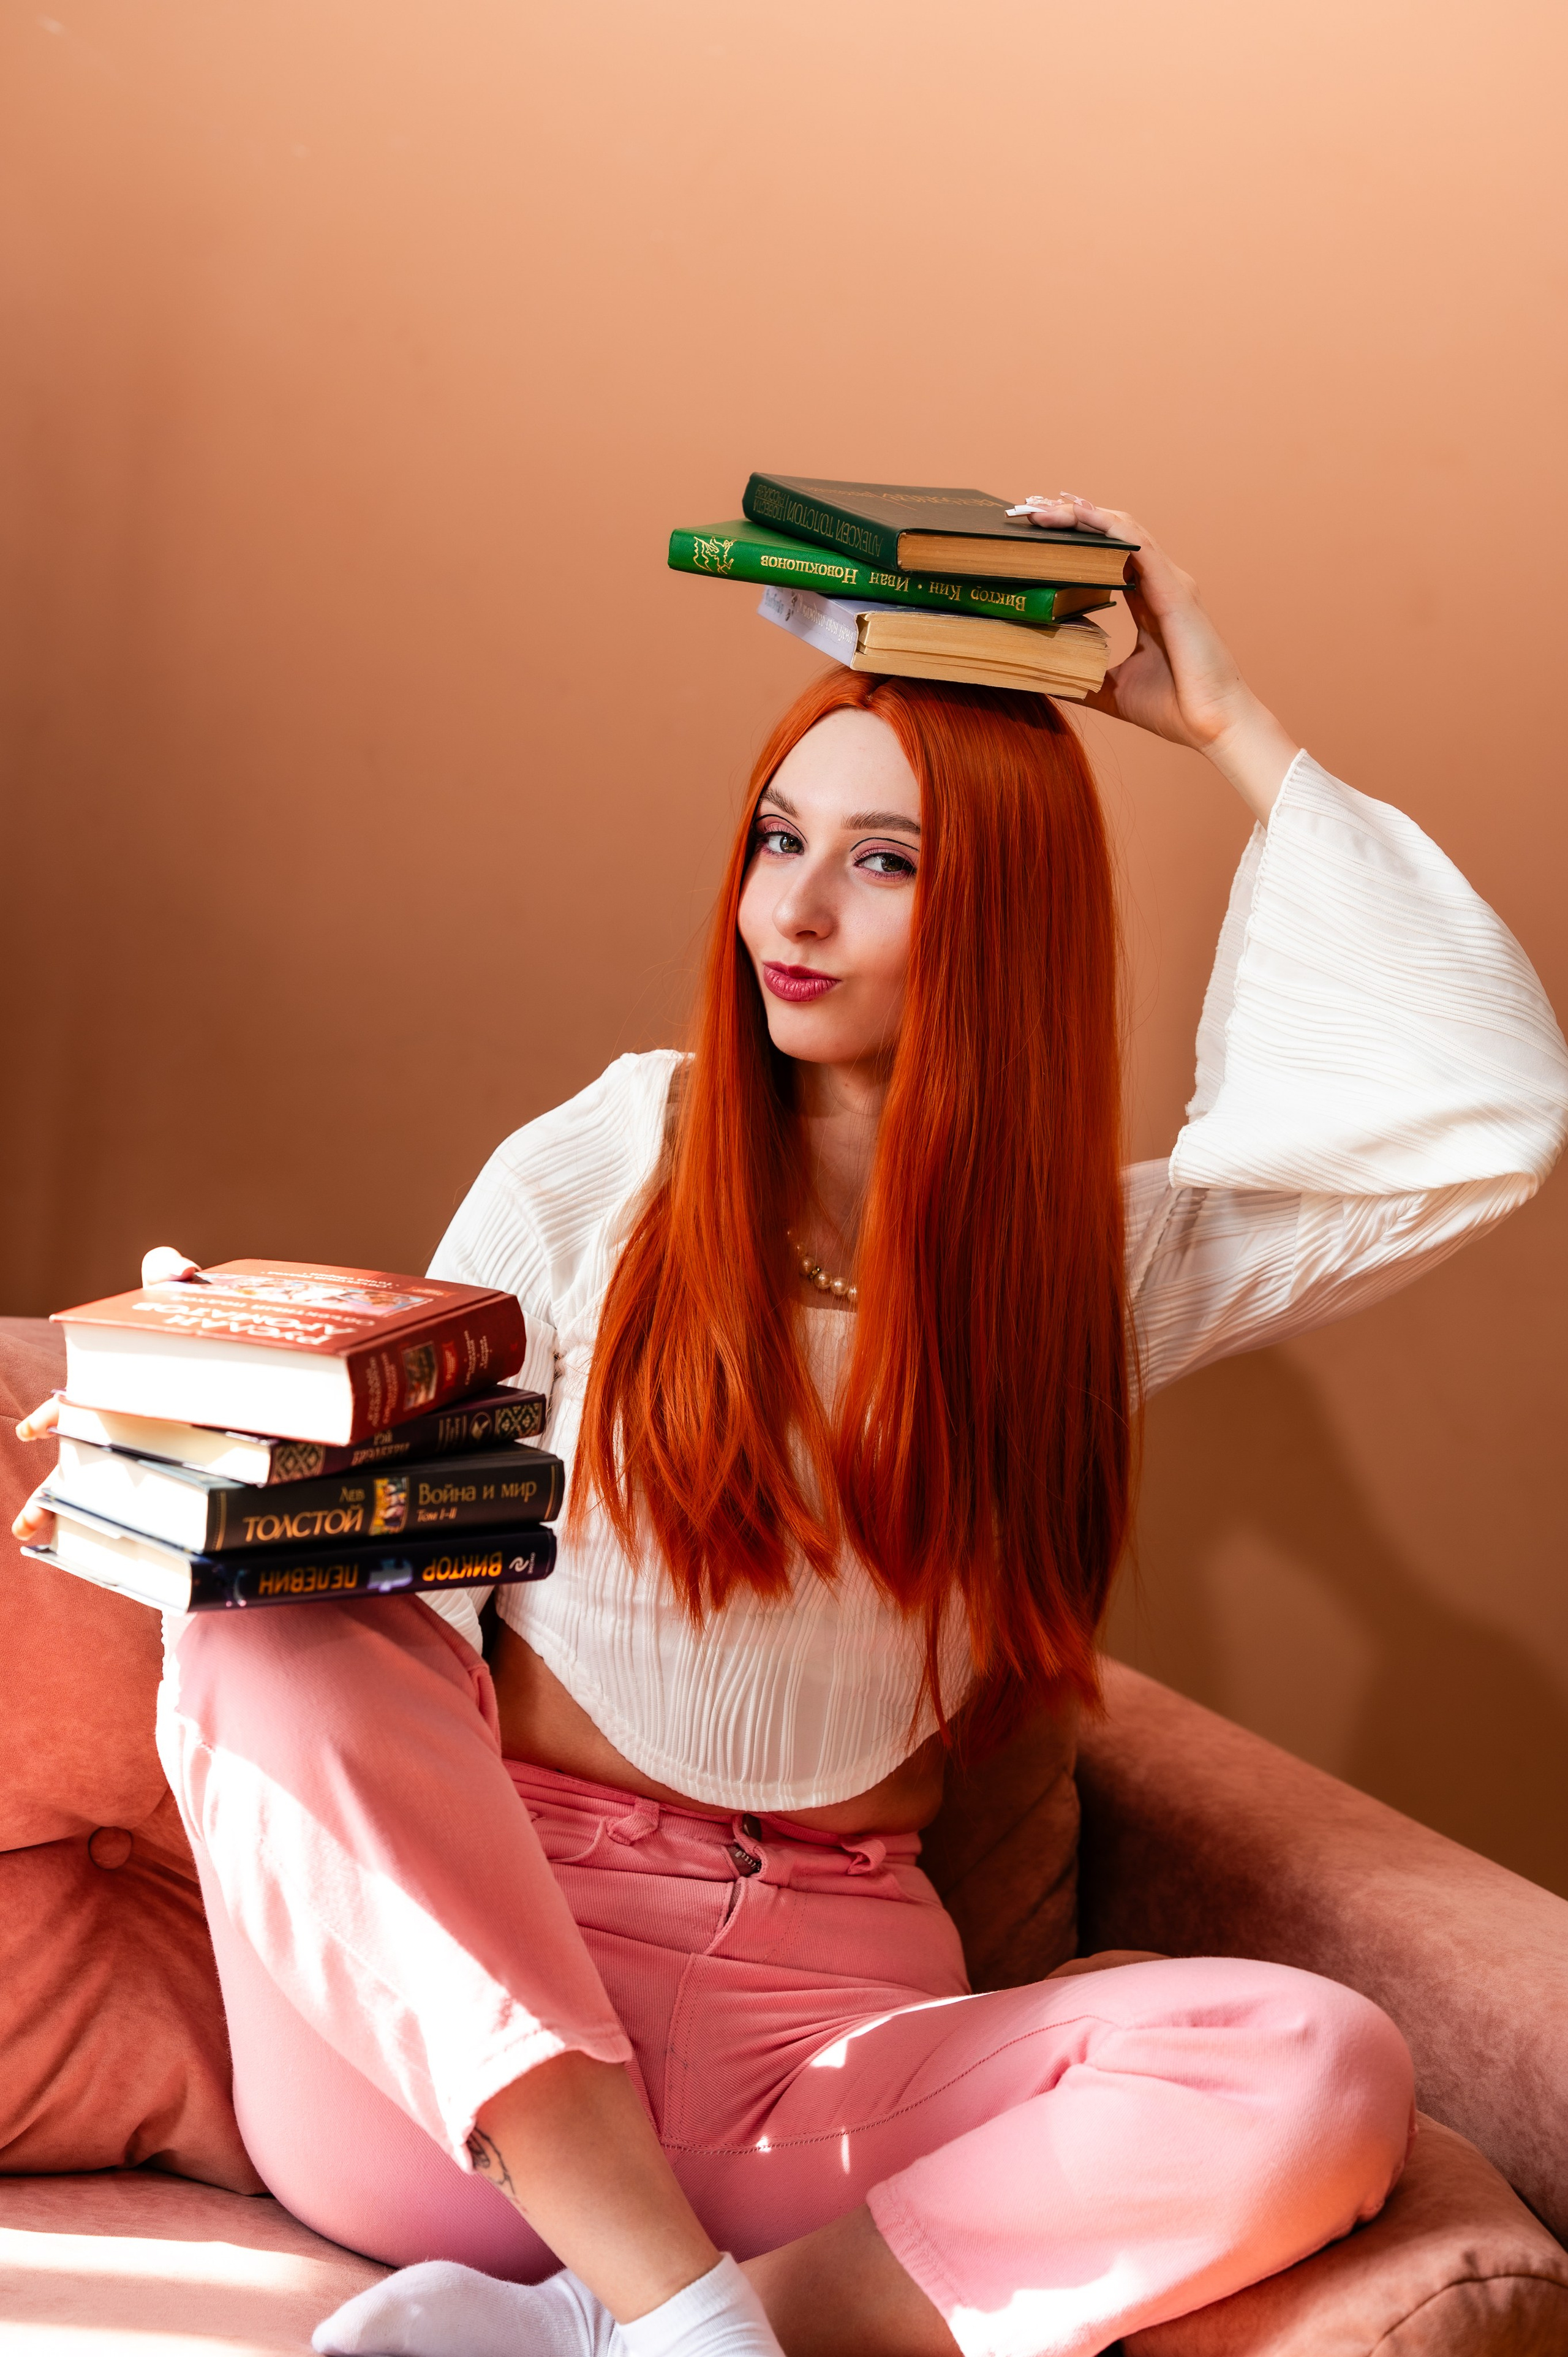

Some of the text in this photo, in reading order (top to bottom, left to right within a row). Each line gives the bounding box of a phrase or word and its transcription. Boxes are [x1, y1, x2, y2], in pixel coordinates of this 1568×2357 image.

[753, 498, 784, 521] ПОВЕСТИ
[755, 484, 786, 506] РАССКАЗЫ
[786, 500, 883, 557] АЛЕКСЕЙ ТОЛСТОЙ
[760, 555, 1027, 611] Виктор Кин Иван Новокшонов
[132, 1302, 357, 1335] АРОМАТОВ
[164, 1314, 334, 1346] РУСЛАН
[418, 1481, 537, 1505] Война и мир
[243, 1504, 364, 1542] ТОЛСТОЙ
[417, 1509, 439, 1523] Том
[258, 1563, 358, 1596] ПЕЛЕВИН
[422, 1551, 503, 1582] ВИКТОР
